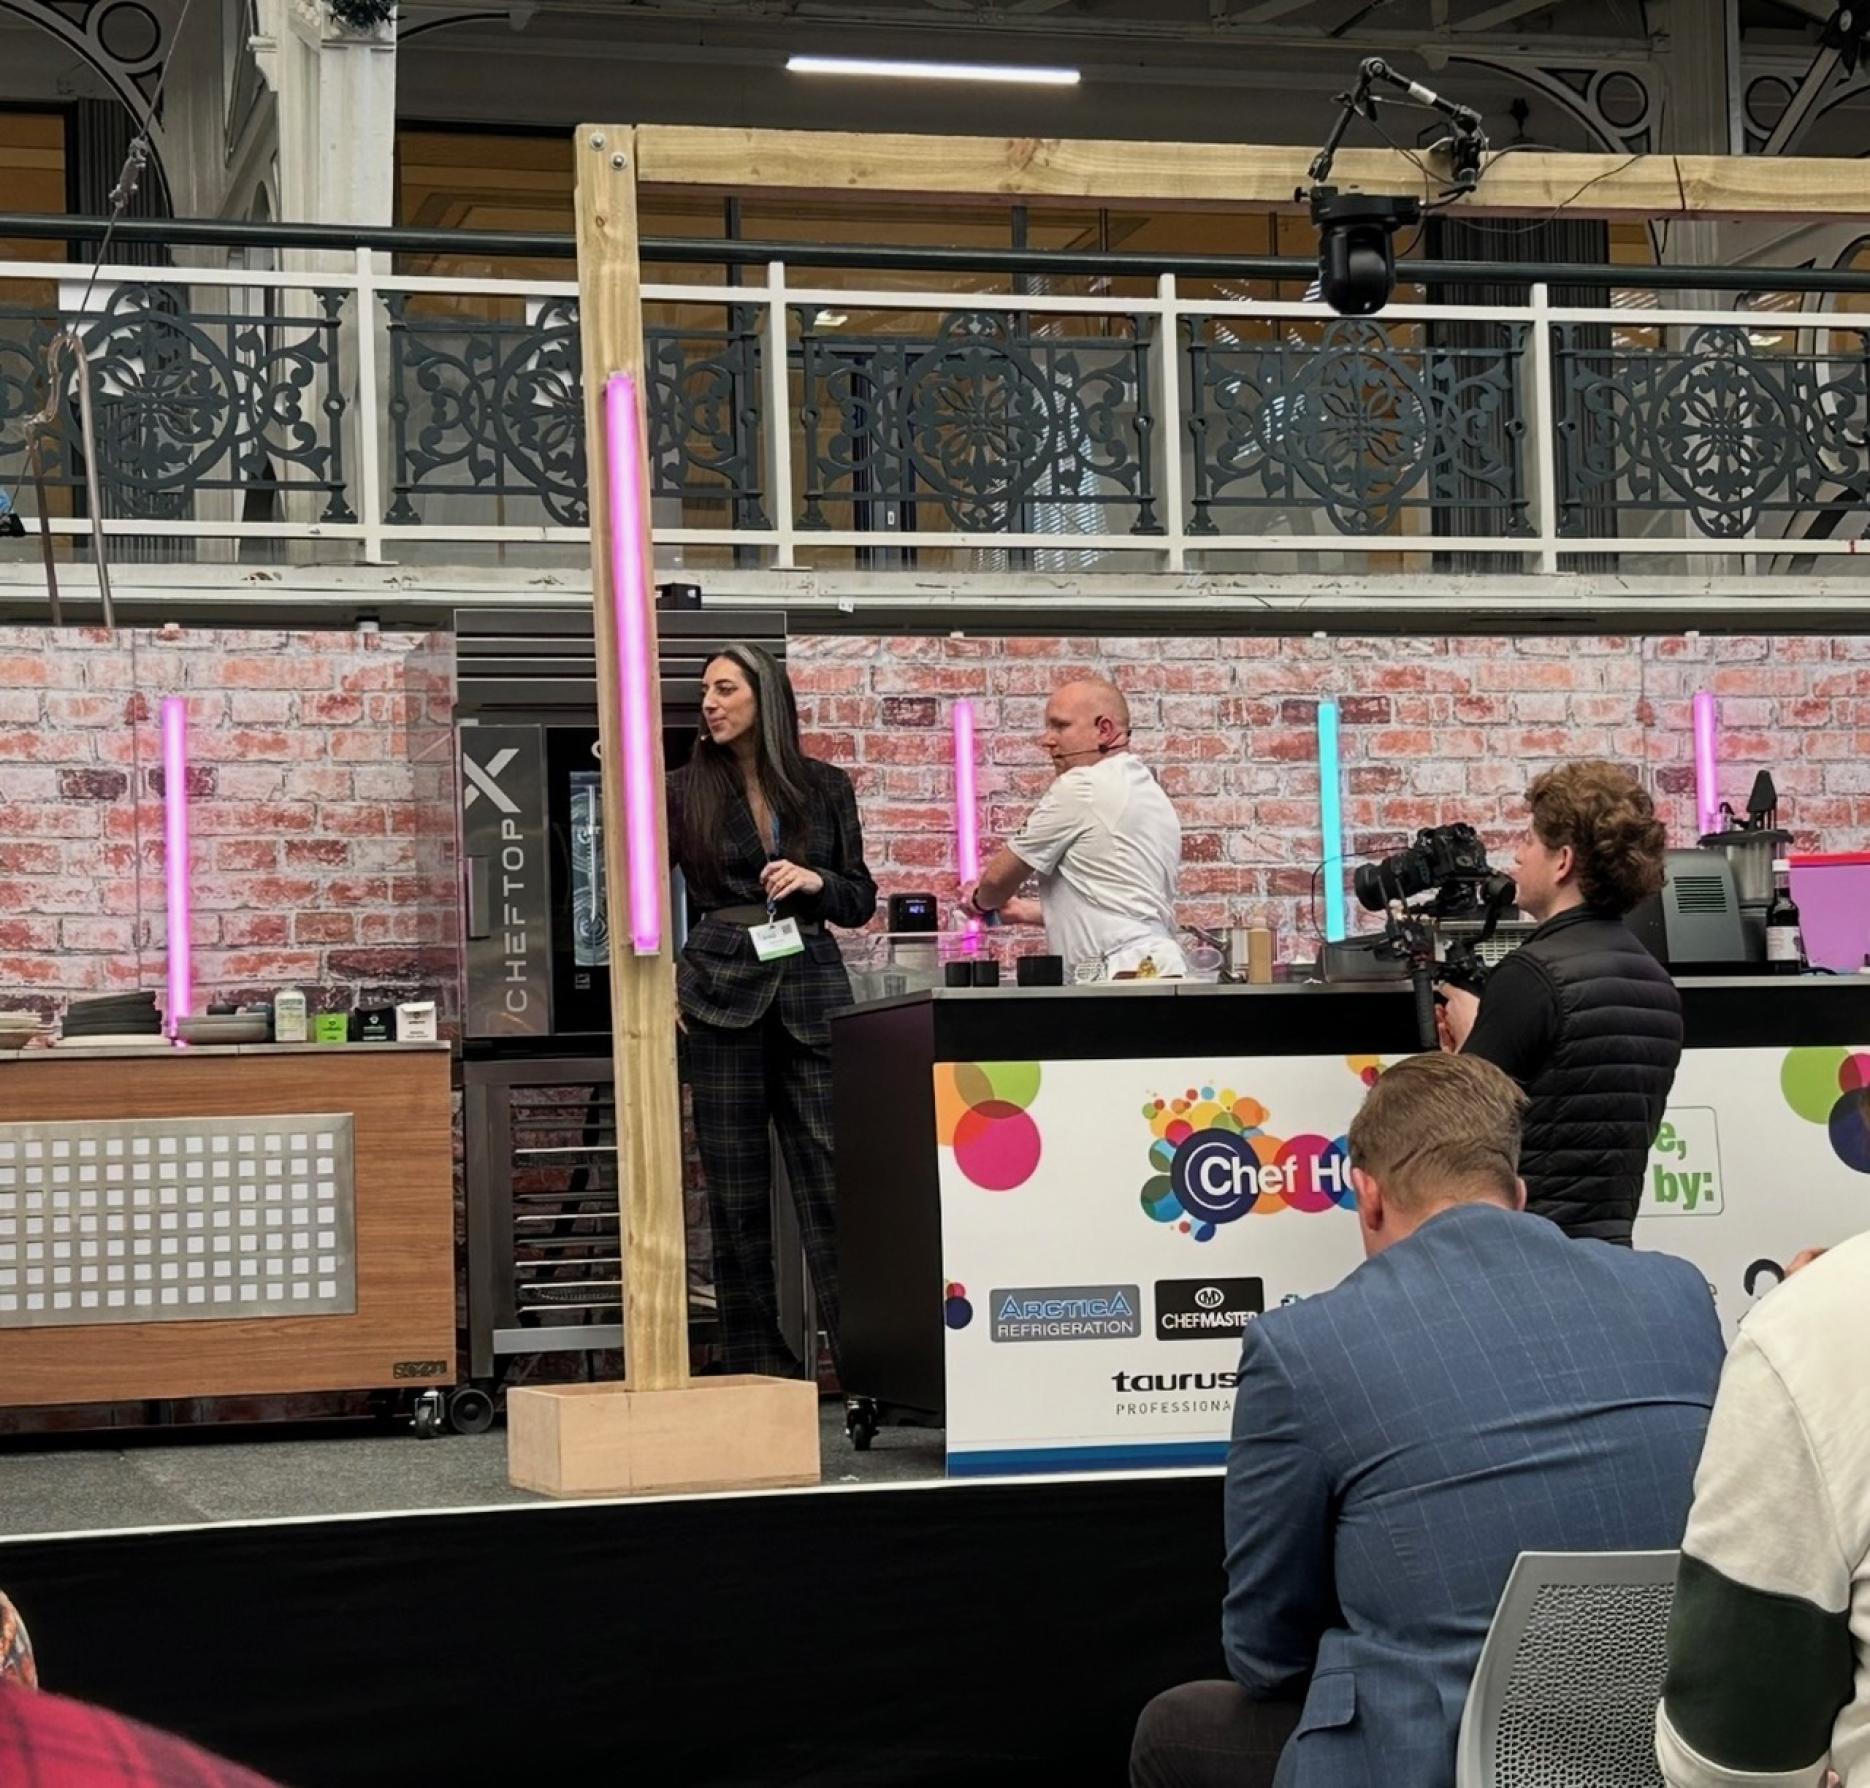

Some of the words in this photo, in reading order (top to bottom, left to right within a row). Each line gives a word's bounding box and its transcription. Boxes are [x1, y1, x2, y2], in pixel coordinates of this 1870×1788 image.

[501, 819, 527, 1013] CHEFTOP
[1200, 1155, 1298, 1196] Chef
[1653, 1163, 1714, 1210] by:
[998, 1290, 1133, 1321] ARCTICA
[998, 1320, 1134, 1338] REFRIGERATION
[1111, 1370, 1239, 1392] taurus
[1116, 1399, 1232, 1415] PROFESSIONA
